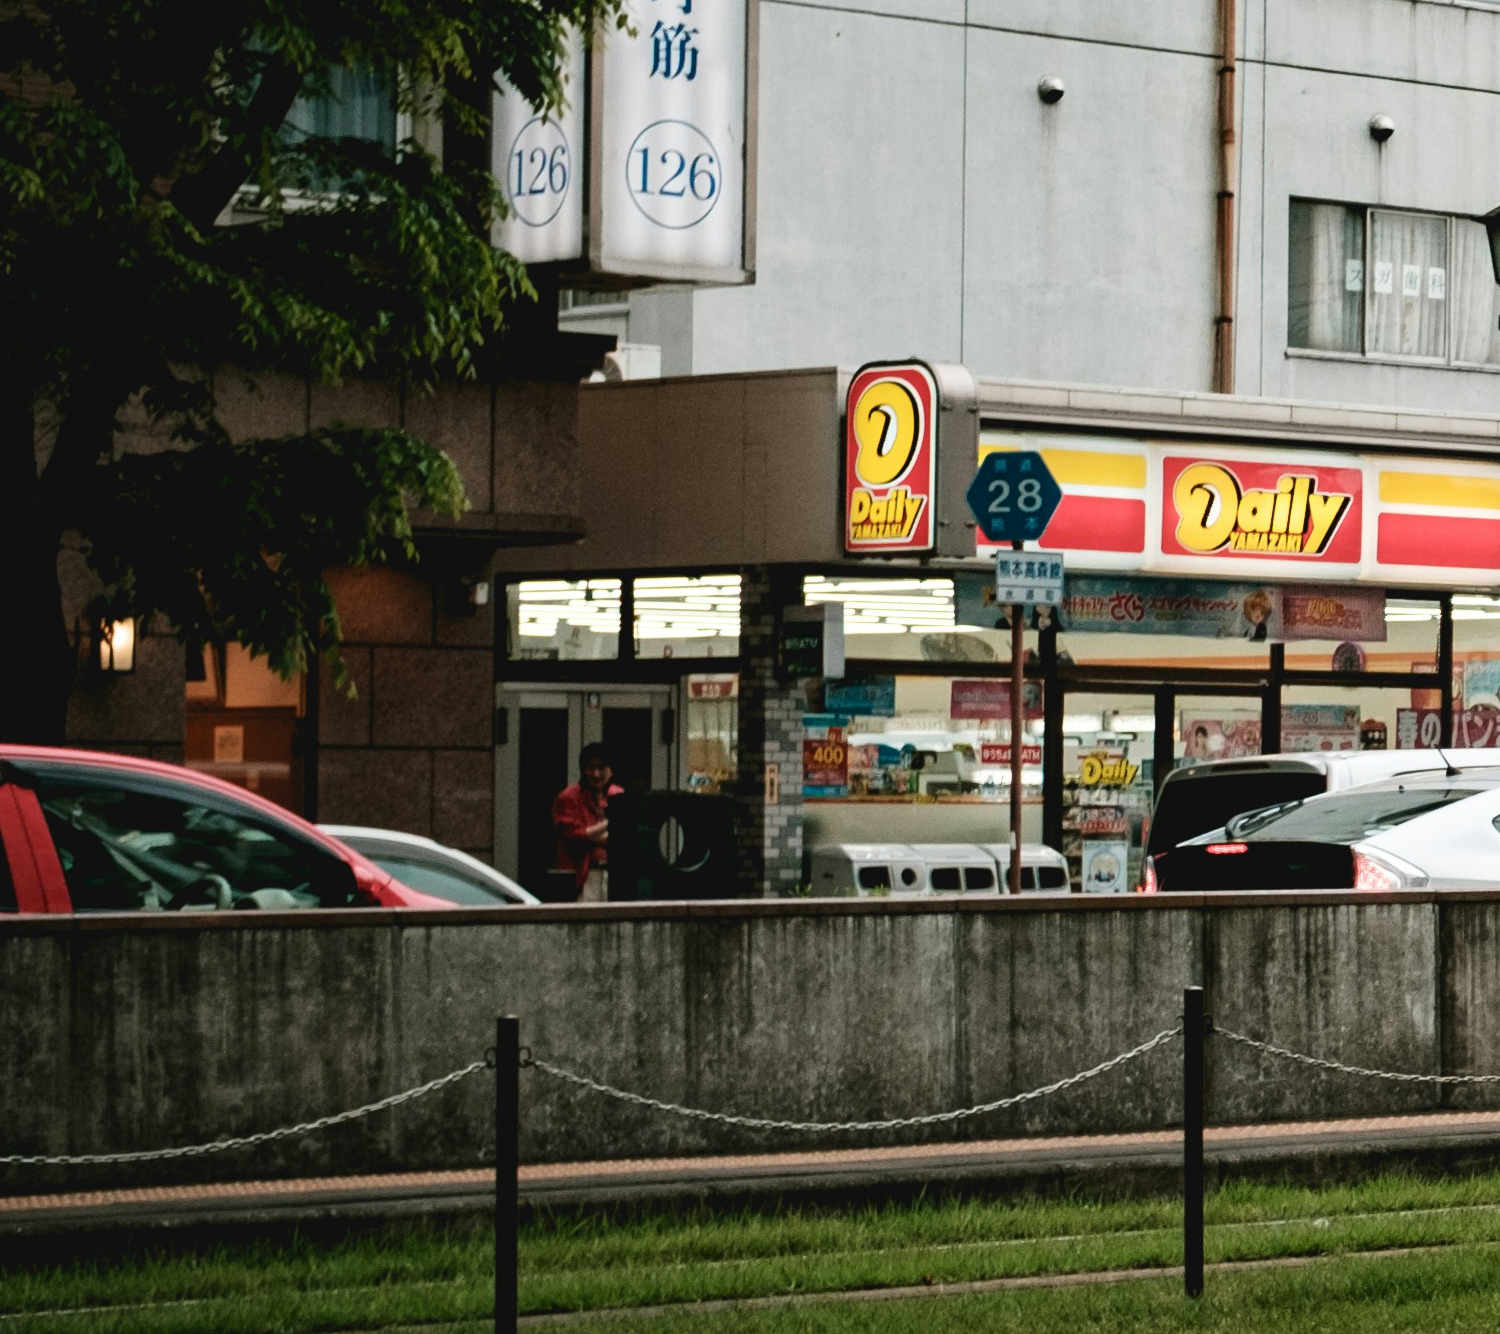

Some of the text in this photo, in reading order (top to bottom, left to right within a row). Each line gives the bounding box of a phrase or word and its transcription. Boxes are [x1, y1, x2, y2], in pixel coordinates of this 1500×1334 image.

[511, 142, 570, 197] 126
[630, 147, 717, 201] 126
[851, 488, 927, 540] Daily
[987, 478, 1044, 514] 28
[1175, 462, 1353, 555] Daily
[851, 523, 903, 541] YAMAZAKI
[1229, 531, 1303, 553] YAMAZAKI
[1108, 590, 1146, 623] さくら
[1082, 756, 1139, 786] Daily
